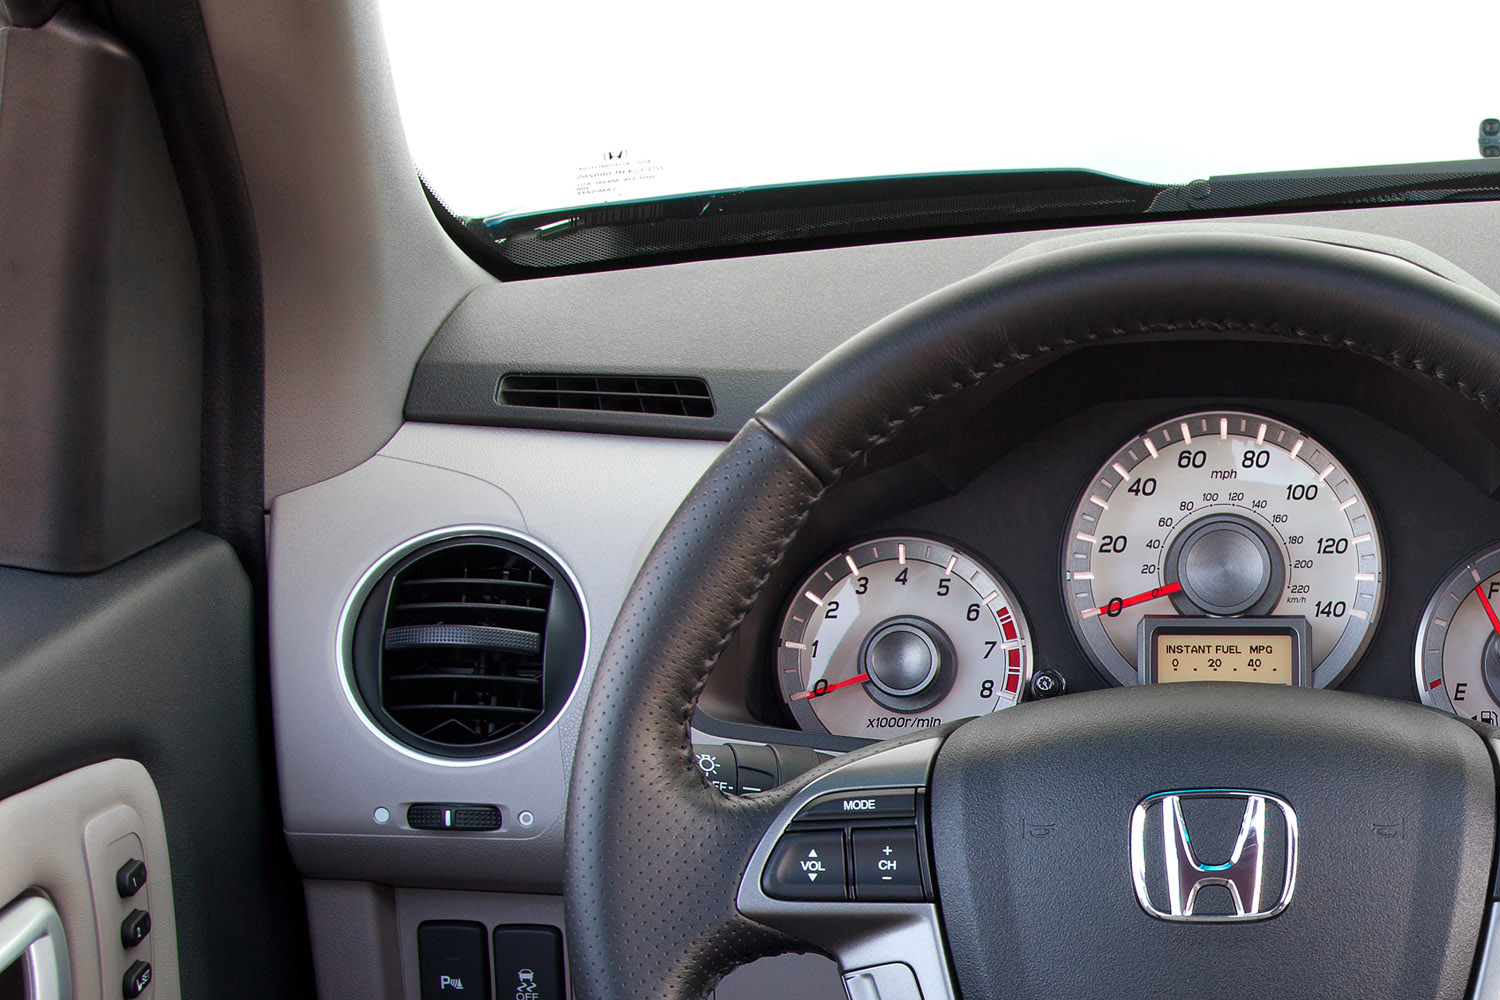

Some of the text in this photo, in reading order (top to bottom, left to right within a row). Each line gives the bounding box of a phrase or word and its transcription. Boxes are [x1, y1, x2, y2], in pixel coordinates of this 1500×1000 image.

[1178, 450, 1207, 468] 60
[1242, 450, 1270, 468] 80
[1211, 469, 1237, 480] mph
[1128, 478, 1157, 496] 40
[1286, 484, 1318, 500] 100
[1203, 493, 1218, 501] 100
[1228, 493, 1244, 501] 120
[1252, 500, 1267, 509] 140
[1180, 502, 1194, 511] 80
[1158, 518, 1173, 527] 60
[1272, 515, 1288, 523] 160
[1099, 535, 1127, 553] 20
[1146, 540, 1160, 549] 40
[1288, 536, 1303, 545] 180
[1317, 538, 1348, 554] 120
[1141, 565, 1155, 574] 20
[1294, 560, 1313, 568] 200
[895, 568, 909, 585] 4
[855, 577, 869, 595] 3
[937, 579, 951, 596] 5
[1291, 585, 1309, 594] 220
[1488, 582, 1500, 599] F
[825, 602, 839, 619] 2
[966, 603, 980, 621] 6
[1107, 597, 1123, 617] 0
[1315, 601, 1346, 618] 140
[811, 640, 819, 658] 1
[983, 641, 997, 659] 7
[1166, 645, 1273, 654] INSTANT FUEL MPG
[1172, 659, 1262, 667] 0 20 40
[813, 679, 828, 696] 0
[980, 680, 995, 698] 8
[1454, 683, 1467, 701] E
[843, 800, 876, 810] MODE
[800, 861, 825, 871] VOL
[878, 860, 897, 870] CH
